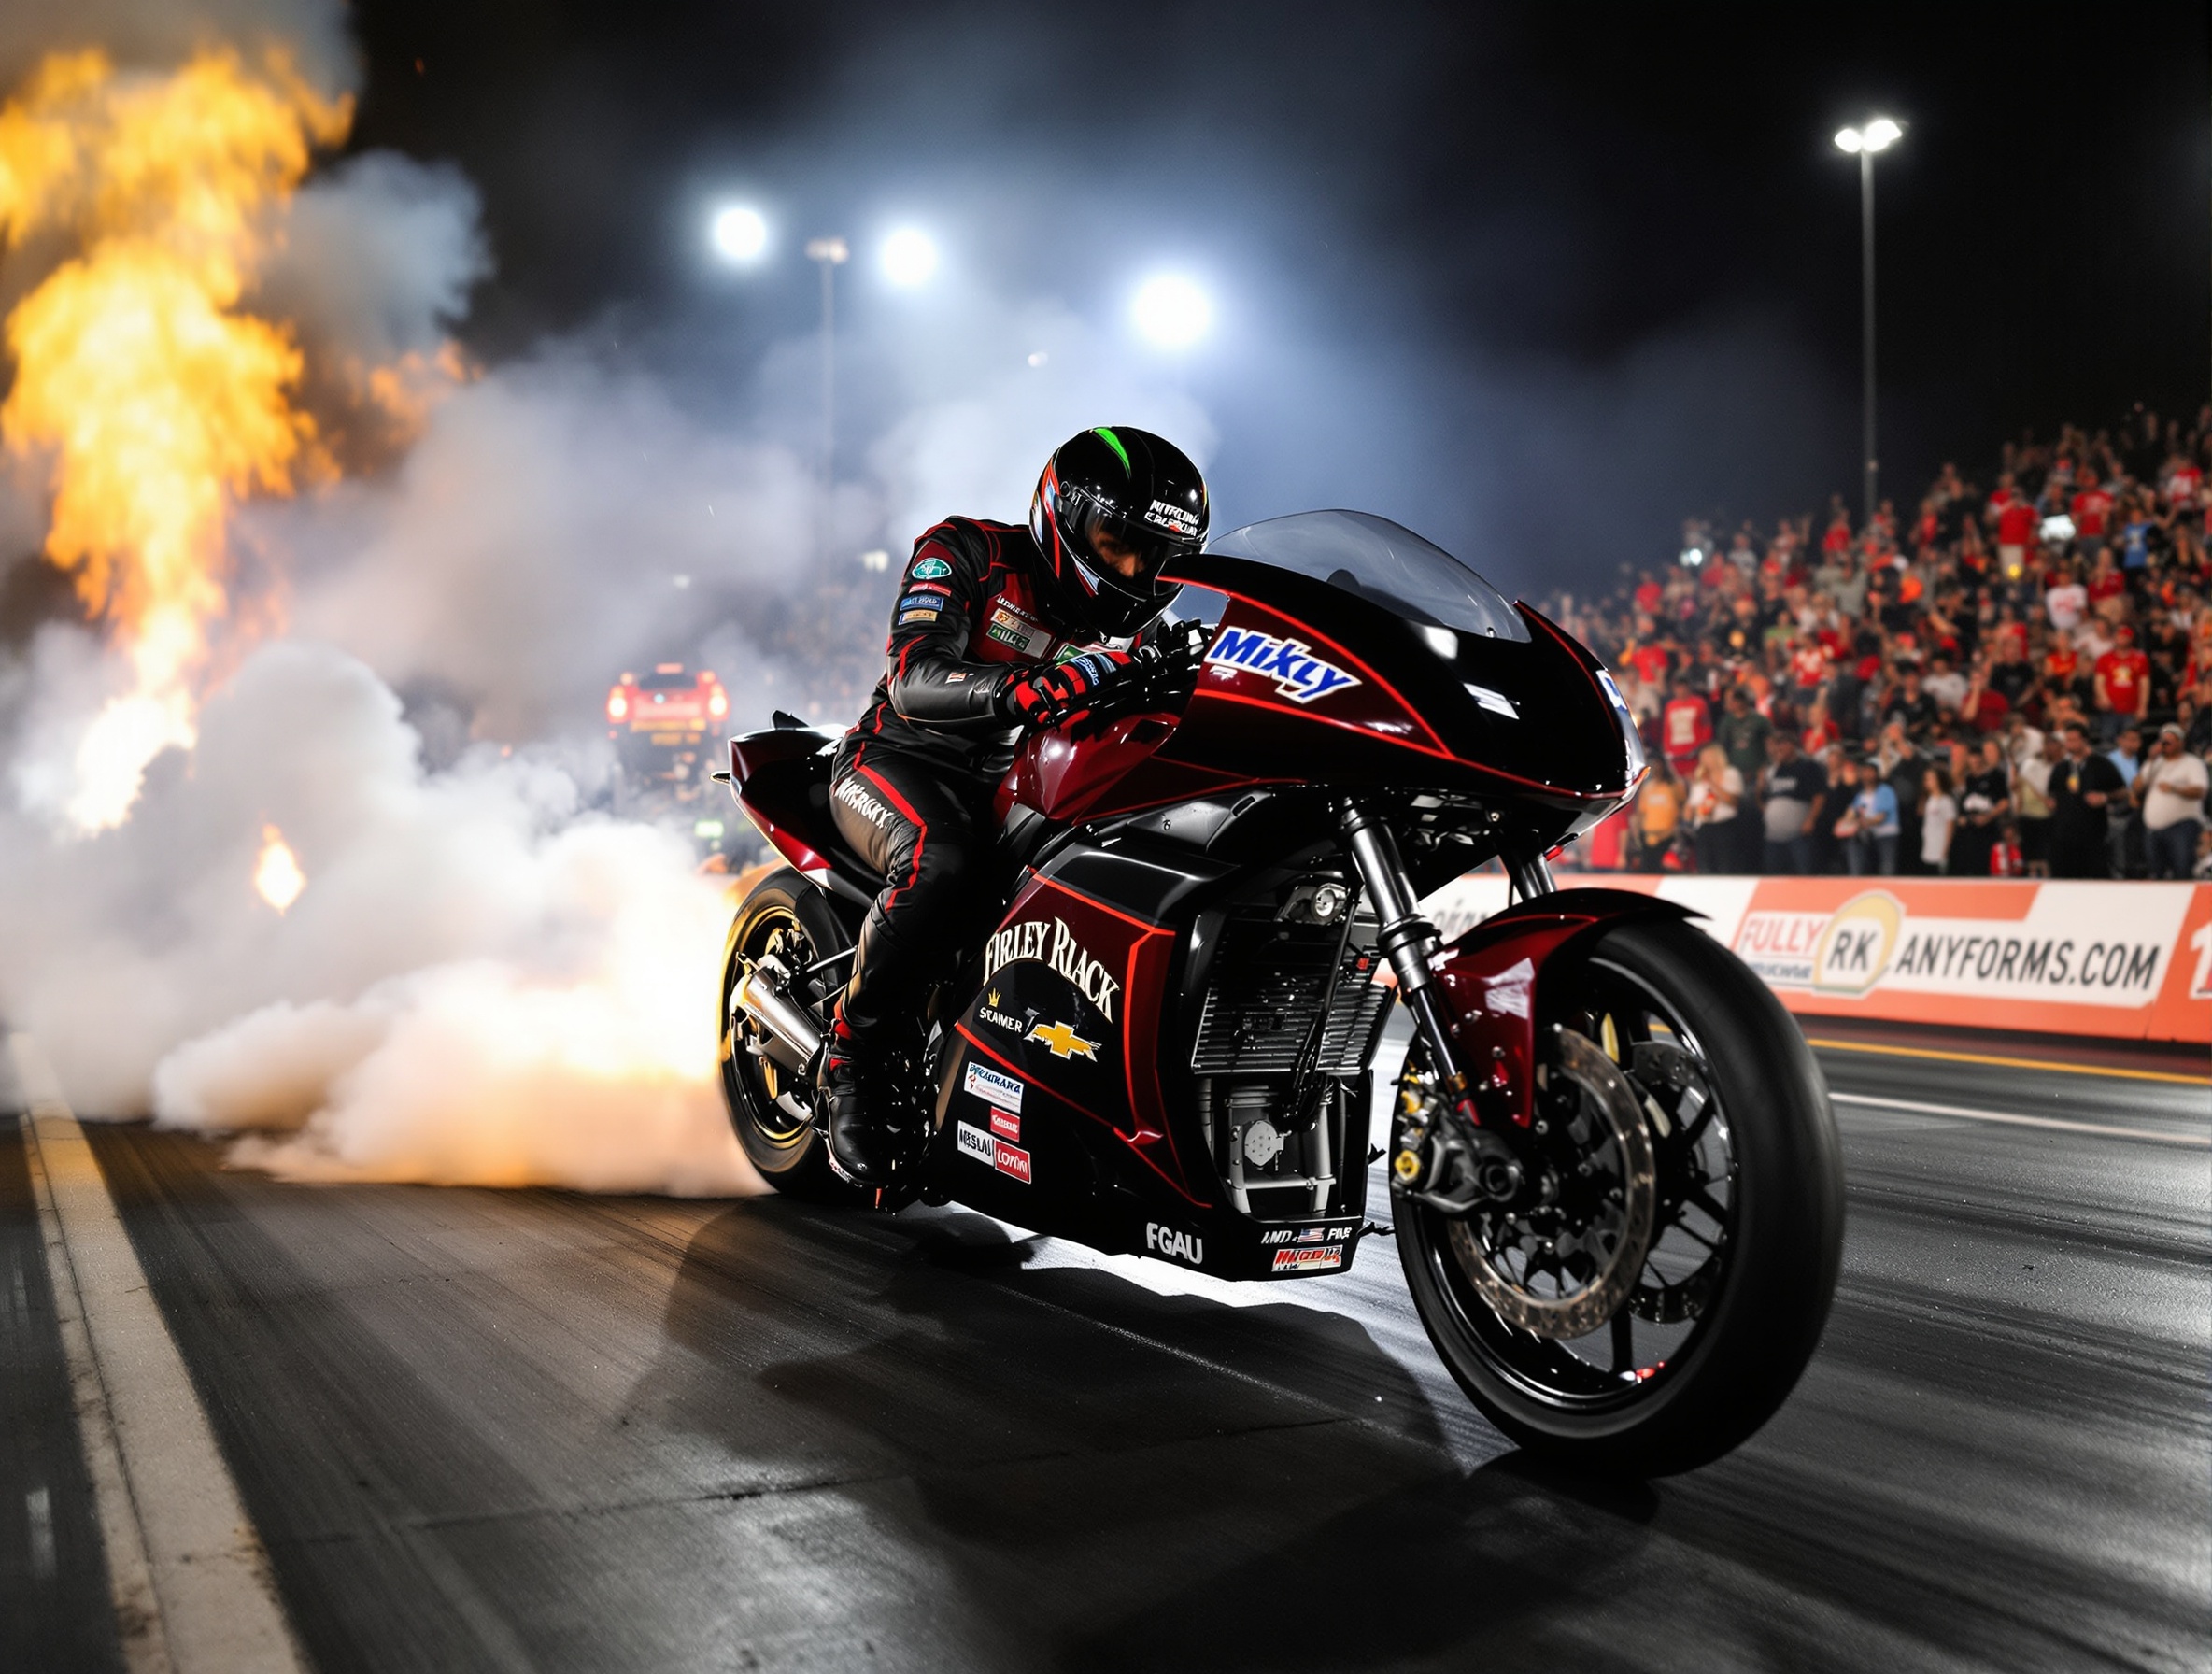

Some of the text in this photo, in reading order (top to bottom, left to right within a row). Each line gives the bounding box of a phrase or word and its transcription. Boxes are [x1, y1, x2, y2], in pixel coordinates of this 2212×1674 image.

[983, 921, 1052, 986] FIRLEY
[1740, 917, 1823, 955] FULLY
[1827, 929, 2161, 991] RK ANYFORMS.COM
[1146, 1221, 1203, 1265] FGAU
